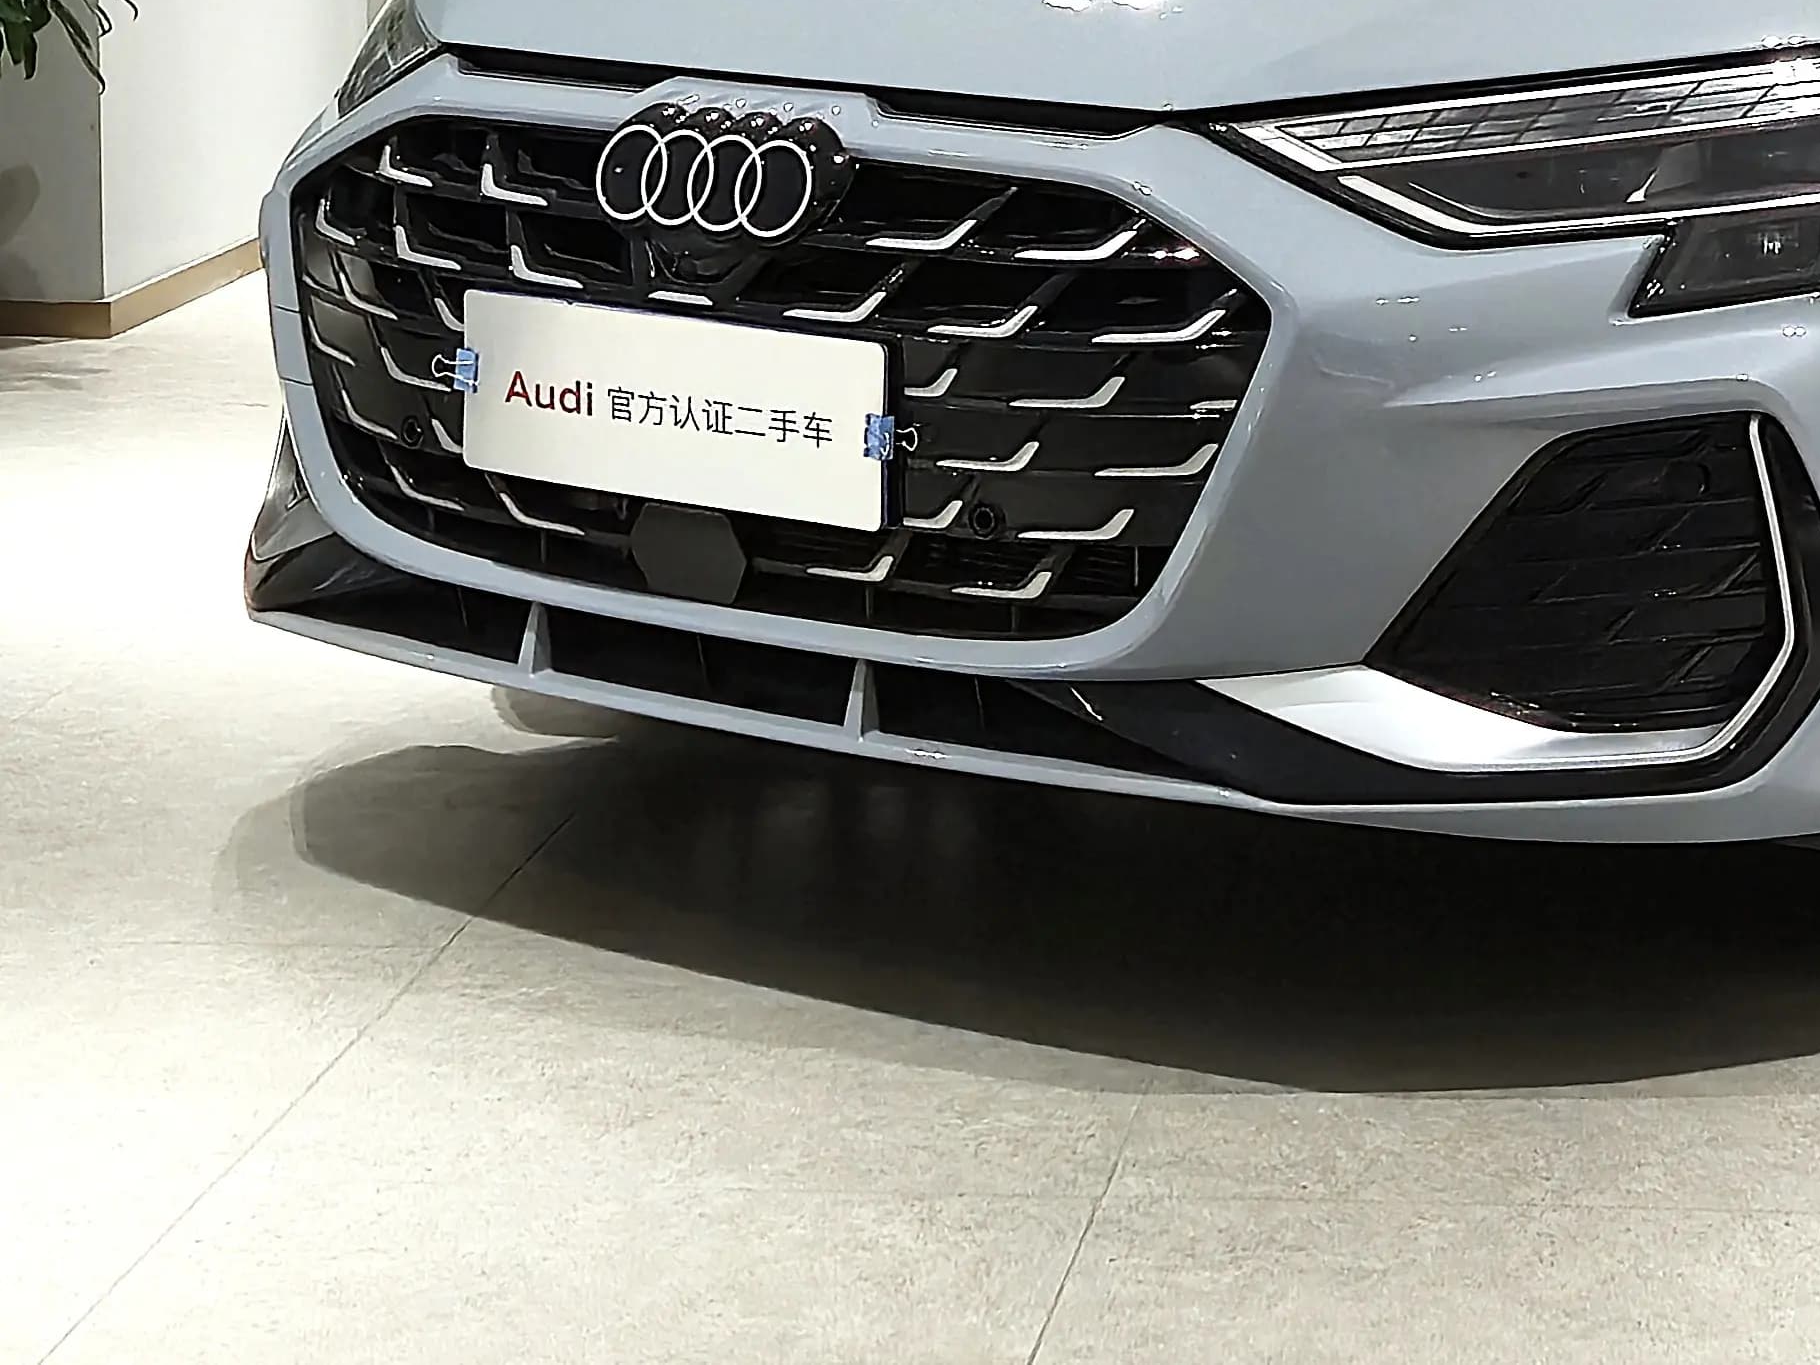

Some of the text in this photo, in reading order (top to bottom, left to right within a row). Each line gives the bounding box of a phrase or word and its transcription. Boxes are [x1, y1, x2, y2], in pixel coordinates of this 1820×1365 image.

[505, 371, 832, 448] Audi 官方认证二手车
